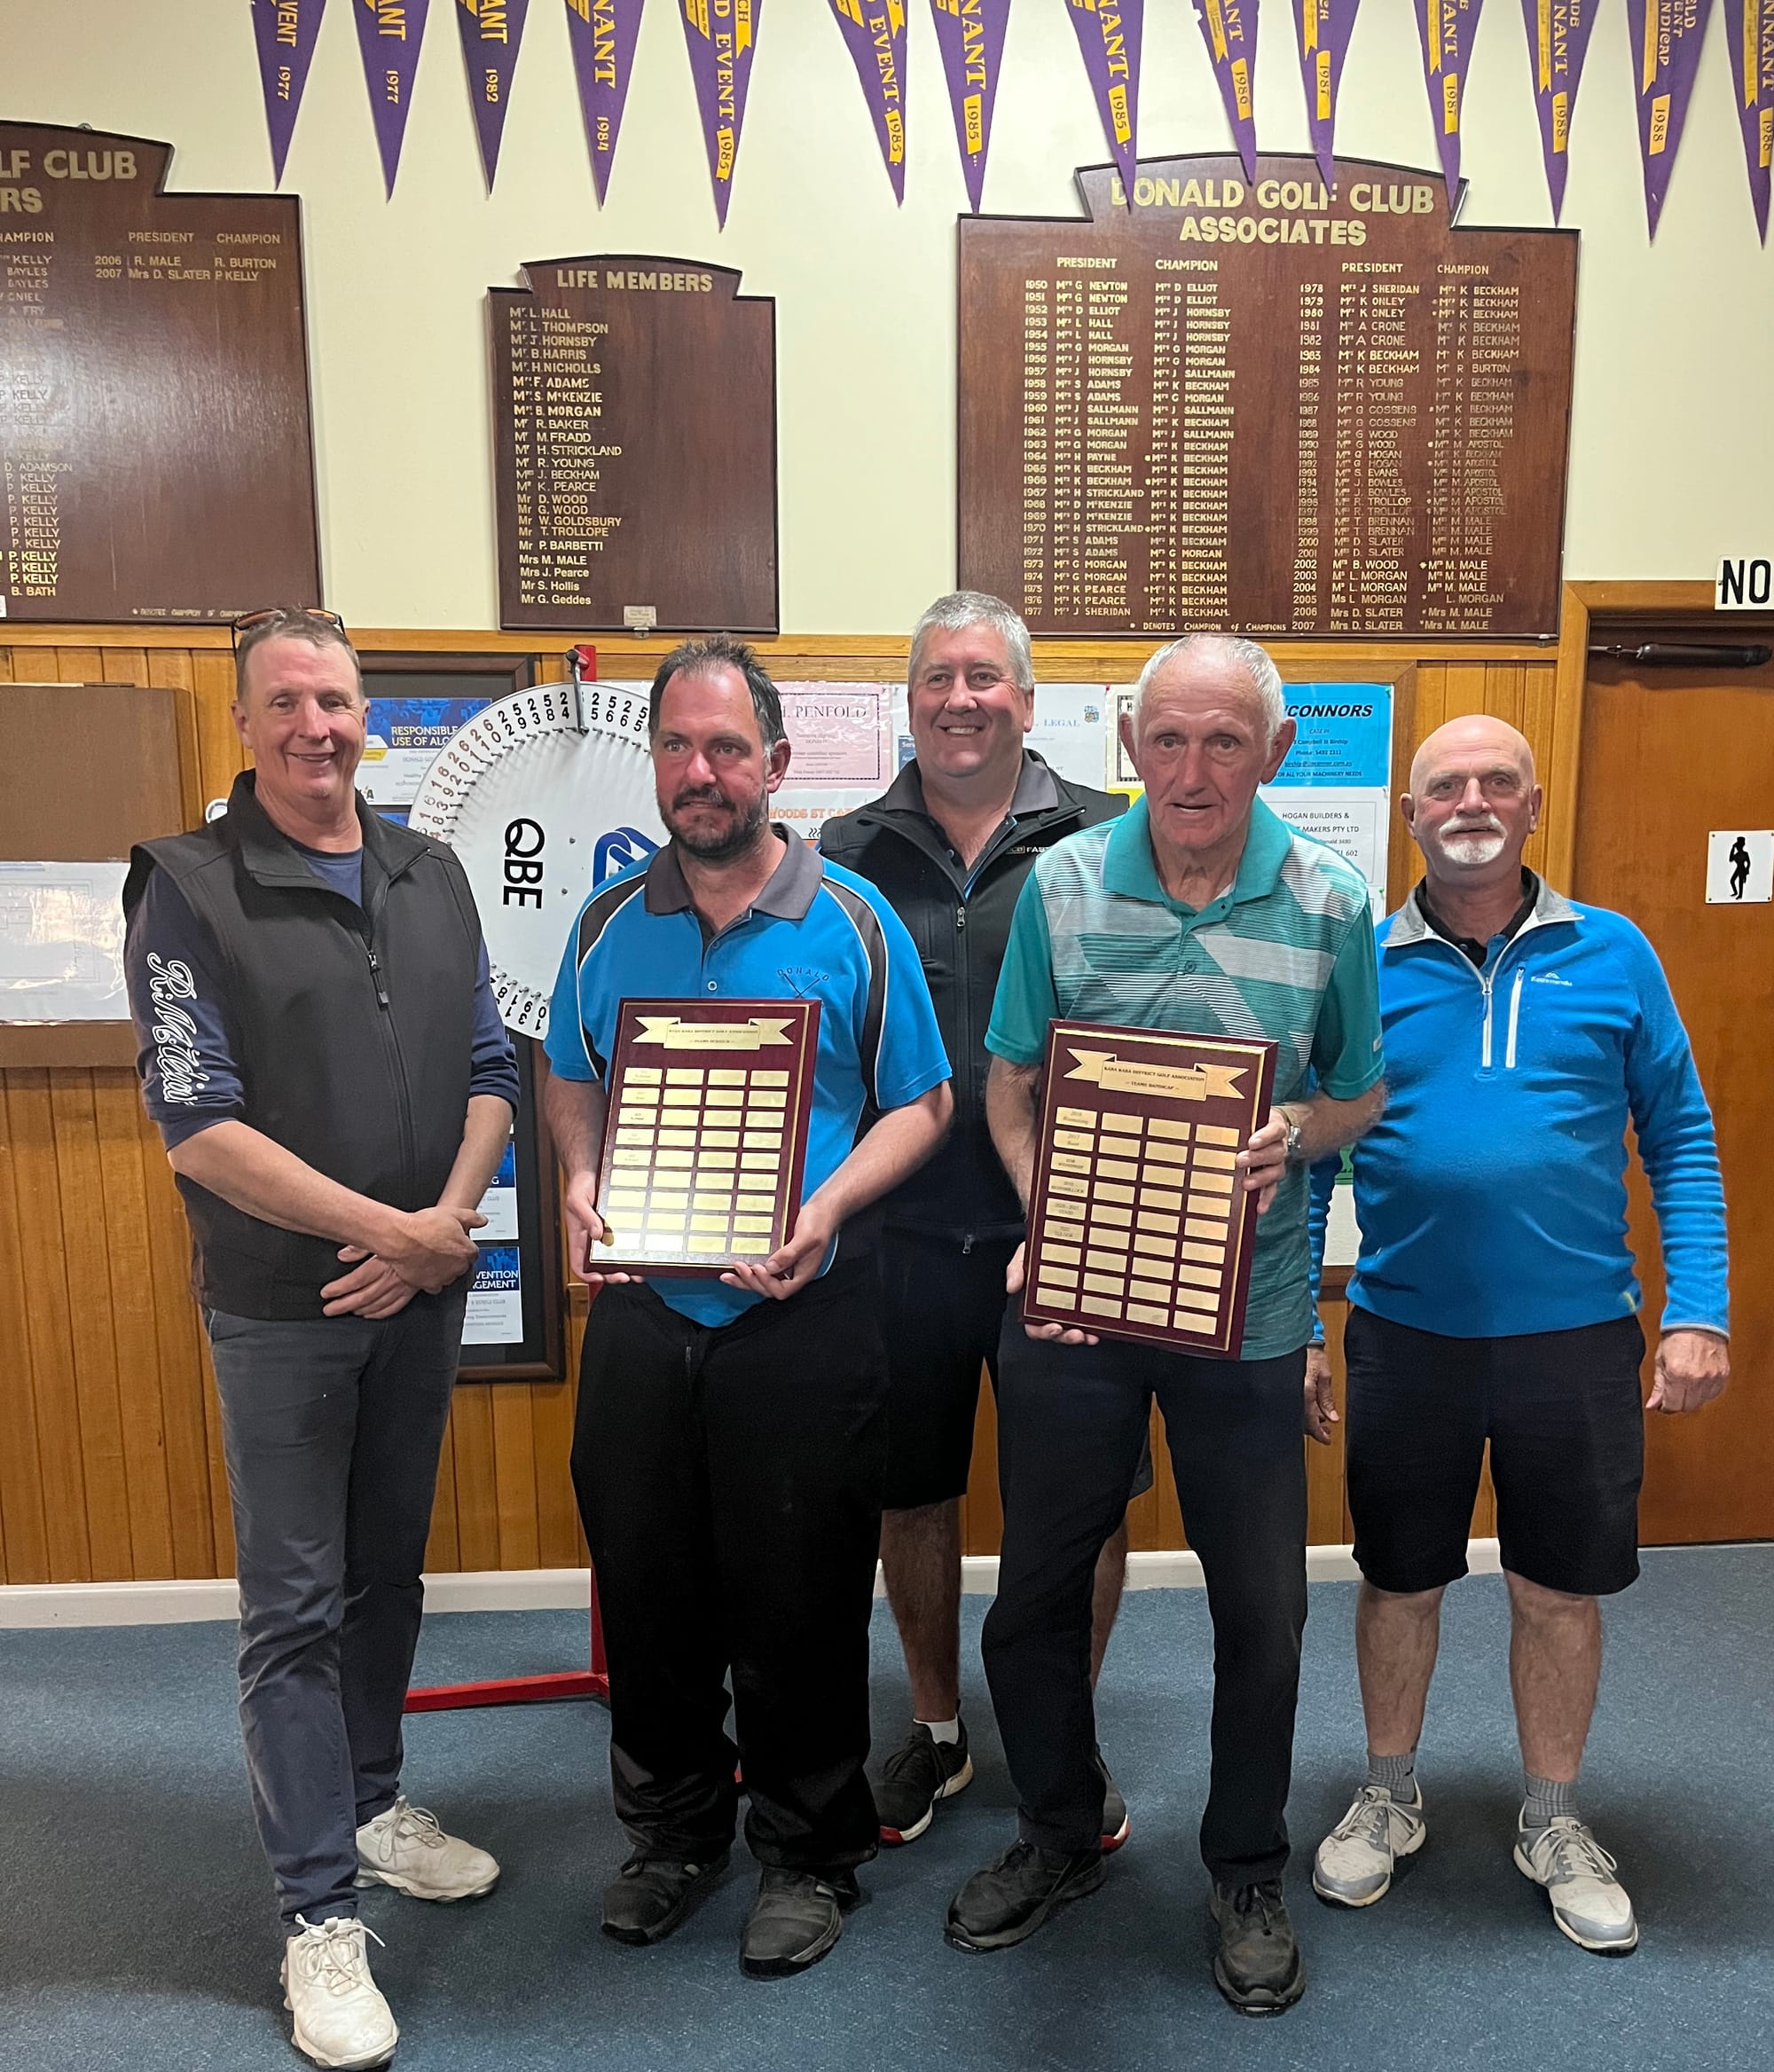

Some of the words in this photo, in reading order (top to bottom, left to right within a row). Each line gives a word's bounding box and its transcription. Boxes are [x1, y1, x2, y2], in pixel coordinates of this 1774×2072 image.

[715, 33, 734, 122] EVENT
[1320, 65, 1330, 96] 1987
[277, 66, 291, 100] 1977
[386, 70, 399, 104] 1977
[486, 68, 498, 103] 1982
[868, 15, 899, 103] EVENT
[889, 118, 902, 153] 1985
[1113, 95, 1127, 129] 1985
[967, 105, 979, 140] 1985
[1556, 104, 1566, 137] 1988
[1653, 108, 1666, 142] 1988
[596, 116, 610, 152] 1984
[719, 136, 733, 169] 1985
[43, 150, 137, 179] CLUB
[1349, 184, 1434, 215] CLUB
[1180, 216, 1366, 246] ASSOCIATES
[129, 232, 193, 242] PRESIDENT
[217, 233, 279, 244] CHAMPION
[95, 255, 121, 265] 2006
[150, 256, 181, 266] MALE
[230, 258, 276, 268] BURTON
[1057, 257, 1117, 268] PRESIDENT
[1156, 260, 1218, 271] CHAMPION
[1342, 263, 1403, 272] PRESIDENT
[1438, 264, 1488, 274] CHAMPION
[96, 269, 122, 278] 2007
[128, 268, 149, 279] Mrs
[169, 270, 210, 279] SLATER
[225, 271, 259, 281] KELLY
[558, 270, 598, 288] LIFE
[607, 271, 712, 292] MEMBERS
[1026, 280, 1048, 289] 1950
[1090, 281, 1127, 290] NEWTON
[1300, 284, 1323, 294] 1978
[1372, 285, 1419, 294] SHERIDAN
[1187, 308, 1231, 317] HORNSBY
[1089, 318, 1113, 327] HALL
[1371, 321, 1405, 331] CRONE
[542, 322, 608, 334] THOMPSON
[543, 335, 597, 347] HORNSBY
[1370, 350, 1418, 360] BECKHAM
[1300, 365, 1320, 373] 1984
[1472, 364, 1510, 373] BURTON
[546, 378, 589, 388] ADAMS
[548, 406, 600, 416] MORGAN
[1369, 405, 1417, 414] COSSENS
[552, 445, 622, 455] STRICKLAND
[20, 463, 73, 472] ADAMSON
[552, 459, 594, 467] YOUNG
[552, 470, 600, 479] BECKHAM
[554, 482, 596, 491] PEARCE
[552, 495, 587, 504] WOOD
[554, 516, 621, 526] GOLDSBURY
[1369, 517, 1414, 526] BRENNAN
[552, 527, 608, 537] TROLLOPE
[520, 541, 532, 550] Mr
[550, 541, 602, 551] BARBETTI
[9, 551, 19, 561] P.
[21, 551, 57, 561] KELLY
[520, 554, 538, 564] Mrs
[542, 555, 553, 564] M.
[557, 555, 587, 565] MALE
[1294, 560, 1316, 569] 2002
[1460, 561, 1487, 569] MALE
[521, 567, 539, 577] Mrs
[554, 568, 589, 577] Pearce
[11, 573, 20, 584] P.
[23, 574, 59, 584] KELLY
[1722, 560, 1770, 605] NO
[12, 586, 22, 595] B.
[27, 586, 56, 596] BATH
[551, 581, 579, 591] Hollis
[522, 594, 535, 603] Mr
[538, 594, 548, 603] G.
[552, 594, 591, 604] Geddes
[1293, 595, 1316, 604] 2005
[1330, 608, 1348, 617] Mrs
[1366, 608, 1402, 616] SLATER
[1292, 620, 1315, 630] 2007
[796, 705, 867, 718] PENFOLD
[391, 726, 459, 735] RESPONSIBLE
[392, 737, 411, 746] USE
[811, 809, 825, 818] ST
[502, 817, 546, 909] QBE
[473, 1280, 515, 1289] GEMENT
